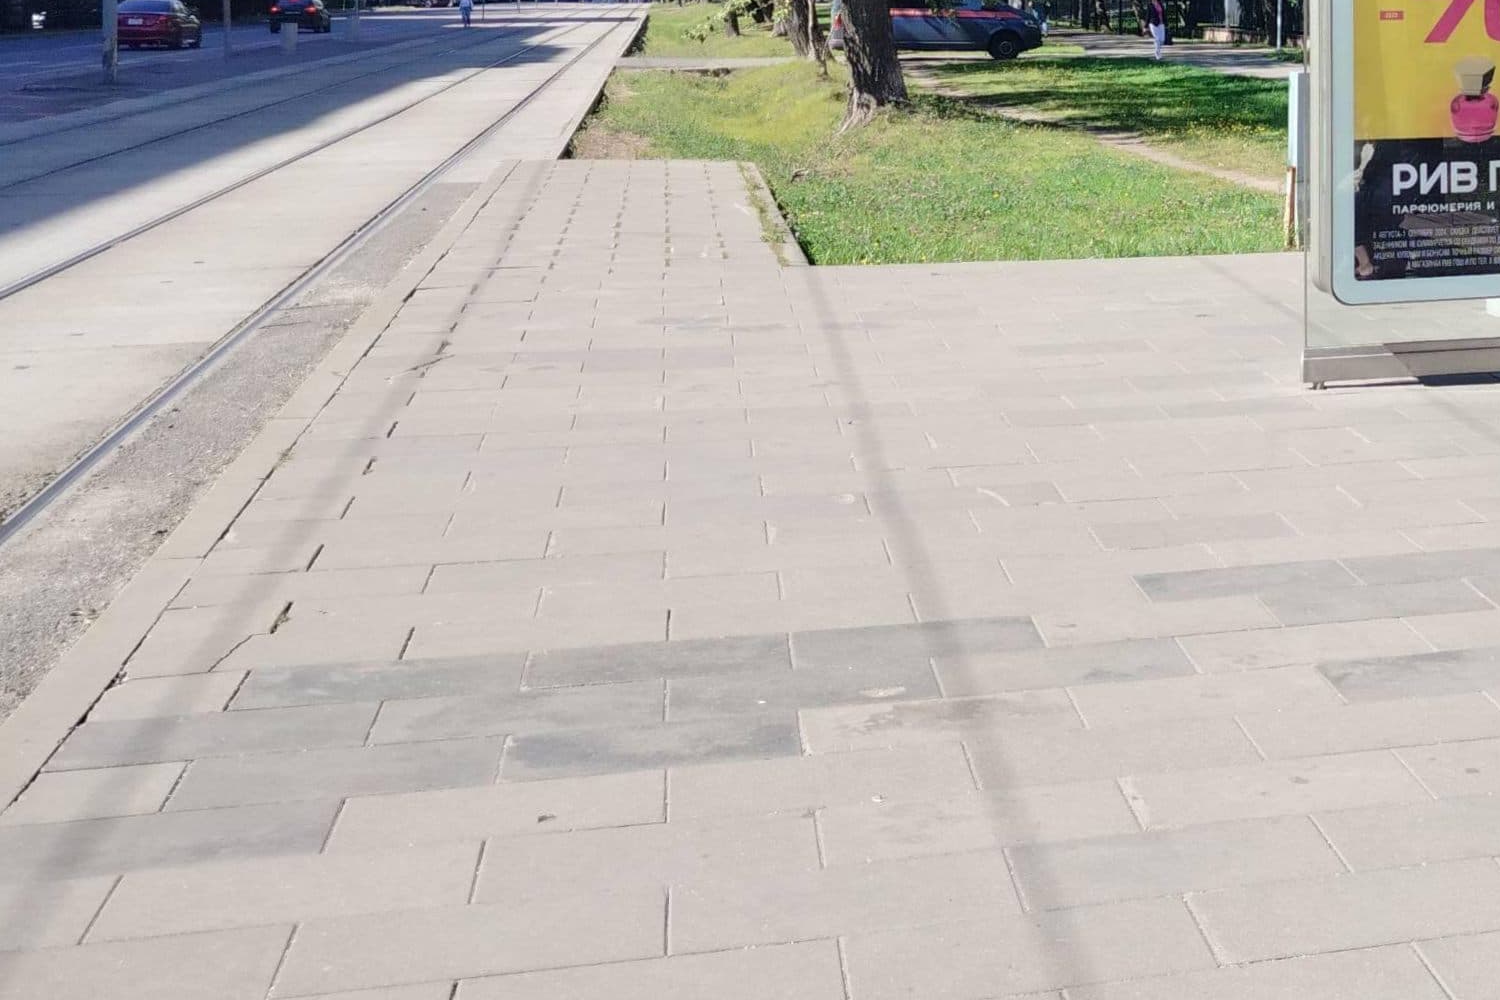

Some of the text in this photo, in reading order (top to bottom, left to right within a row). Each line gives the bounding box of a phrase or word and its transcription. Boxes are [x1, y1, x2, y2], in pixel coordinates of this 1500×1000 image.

[1392, 161, 1478, 195] РИВ
[1393, 202, 1481, 215] ПАРФЮМЕРИЯ
[1487, 201, 1495, 210] И
